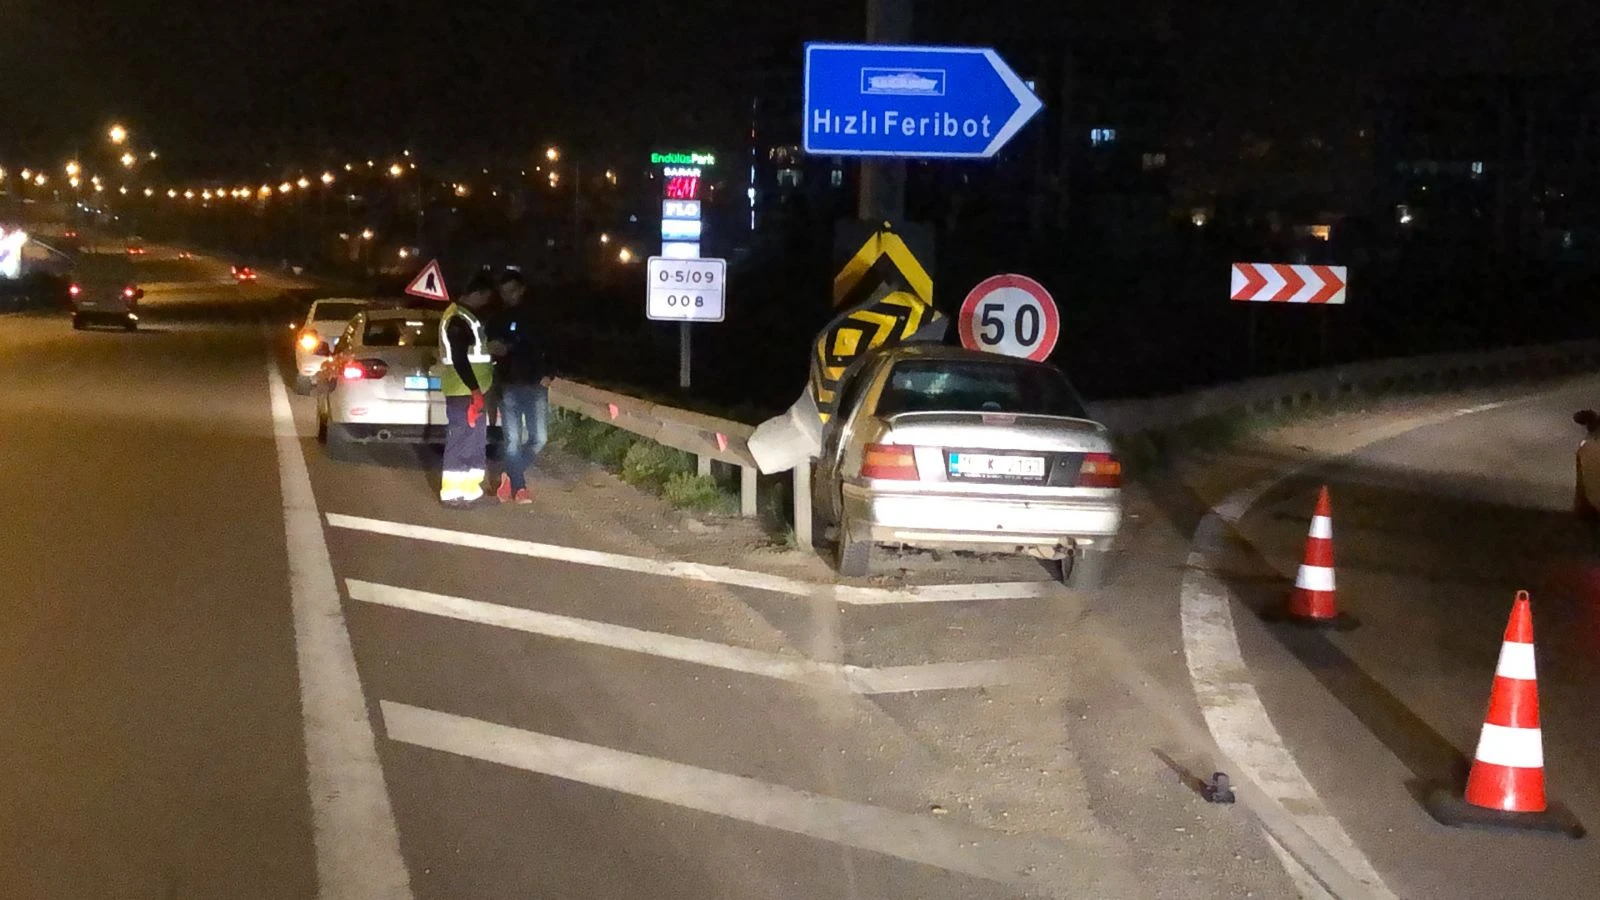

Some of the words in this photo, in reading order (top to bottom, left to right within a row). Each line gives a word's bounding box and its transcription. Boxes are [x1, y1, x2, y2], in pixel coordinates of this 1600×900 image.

[813, 109, 876, 135] Hızlı
[884, 111, 990, 138] Feribot
[667, 295, 704, 308] 008
[980, 303, 1040, 347] 50
